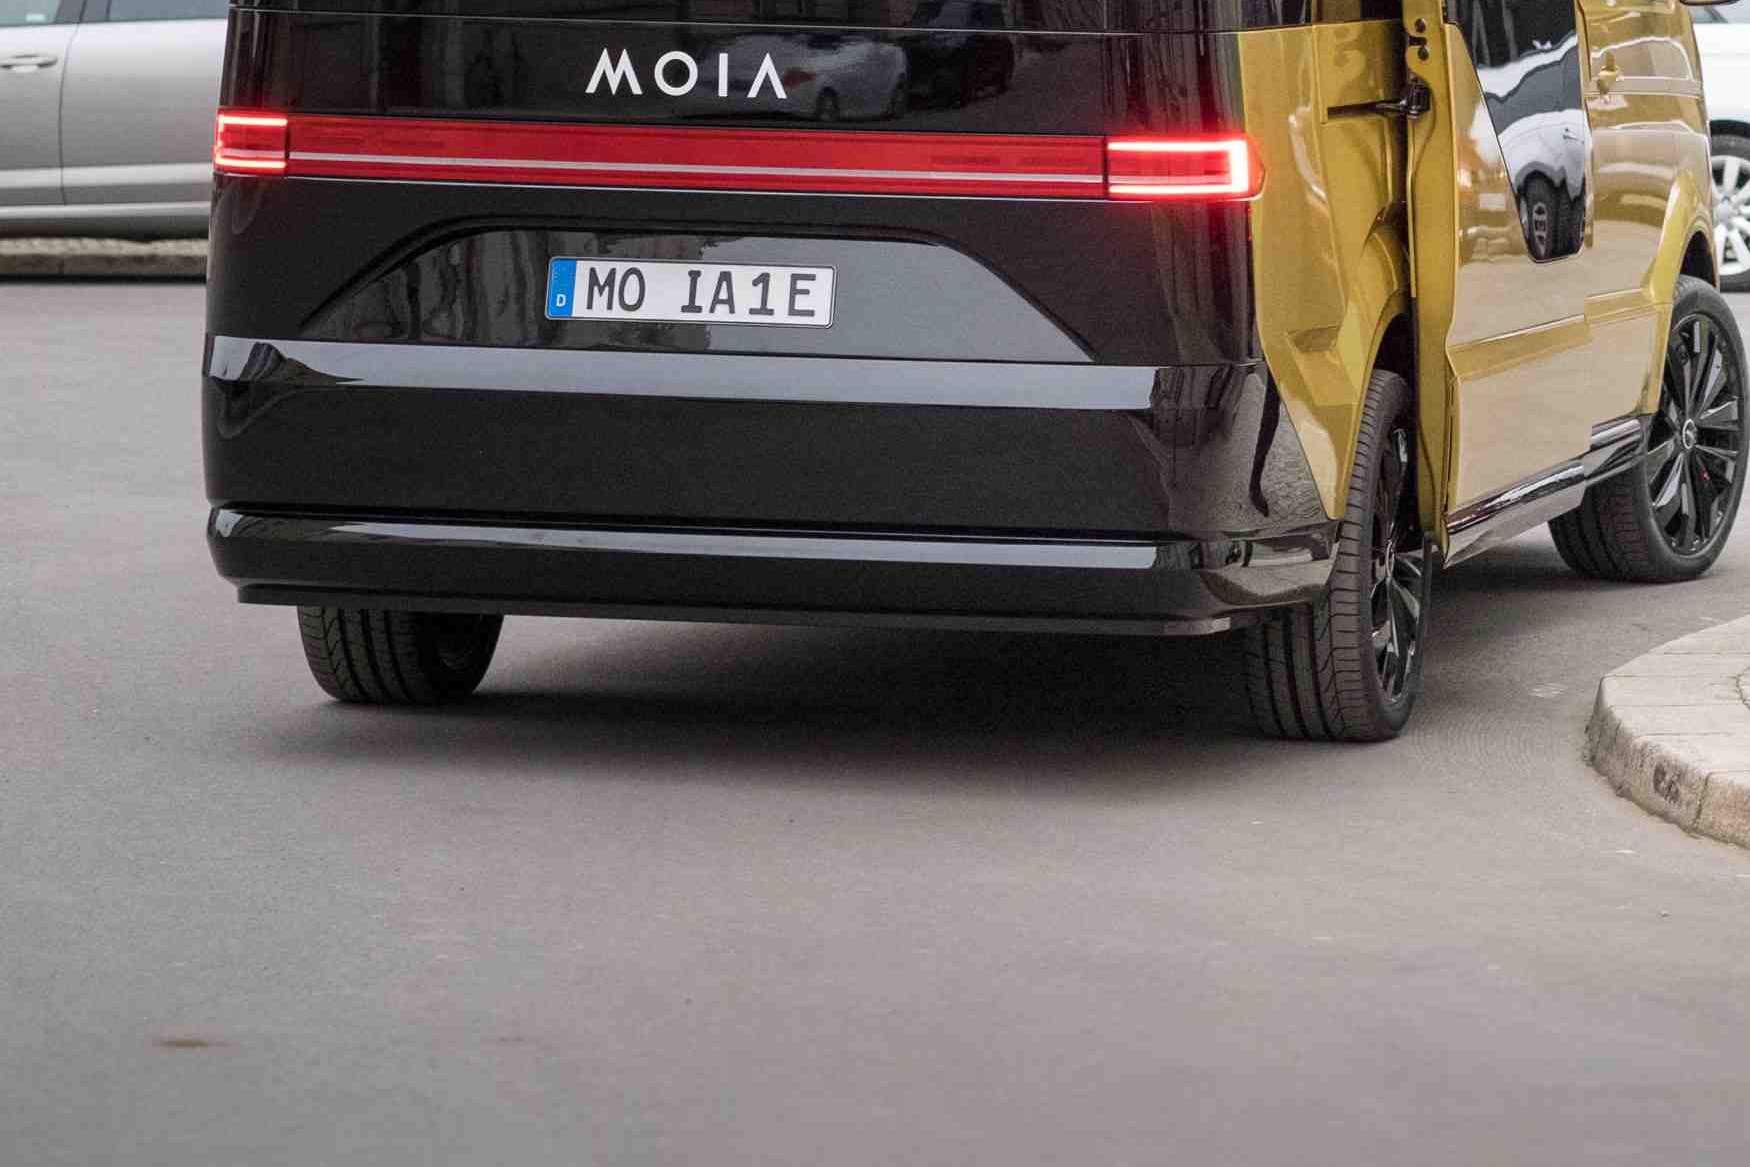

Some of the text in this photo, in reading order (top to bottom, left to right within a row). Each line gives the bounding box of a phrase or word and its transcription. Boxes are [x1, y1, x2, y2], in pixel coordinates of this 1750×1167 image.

[585, 48, 788, 99] MOIA
[555, 294, 566, 308] D
[586, 266, 817, 318] MO IA1E
